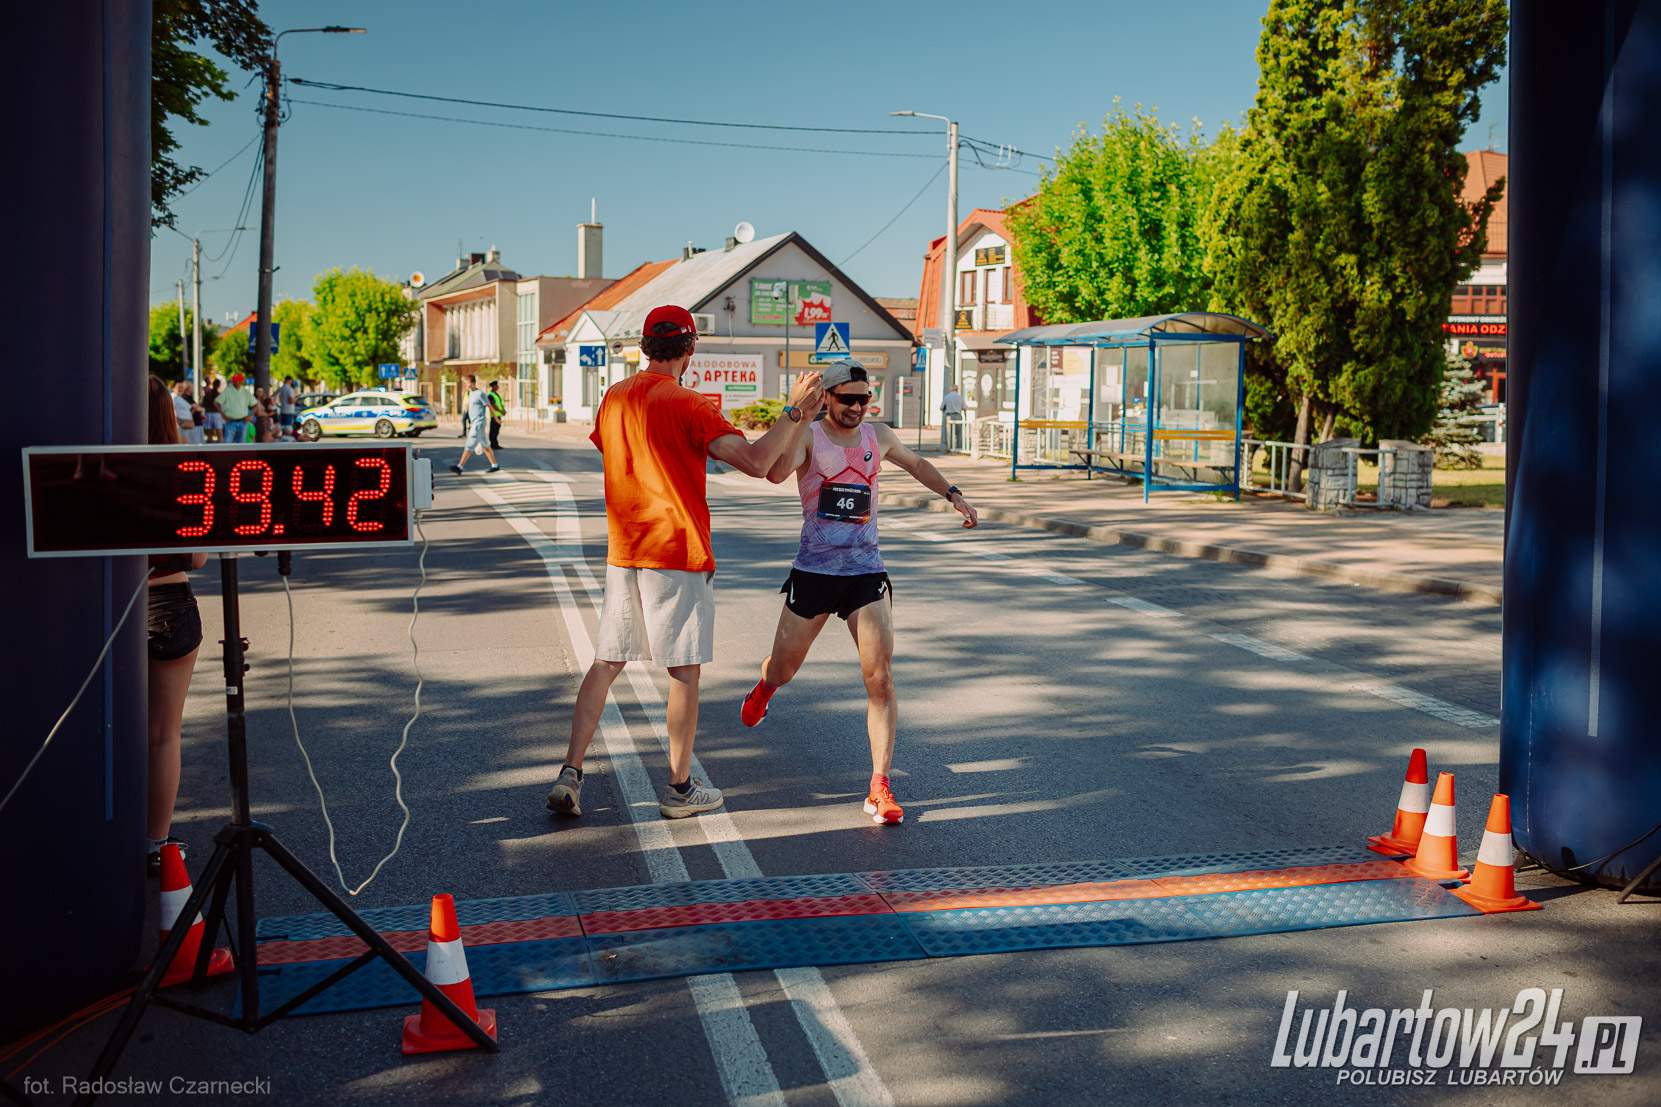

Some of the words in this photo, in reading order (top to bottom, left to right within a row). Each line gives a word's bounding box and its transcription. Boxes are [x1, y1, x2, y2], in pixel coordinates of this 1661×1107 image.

[1480, 324, 1506, 334] ODZ
[690, 359, 757, 368] AŁODOBOWA
[704, 370, 757, 382] APTEKA
[176, 457, 391, 538] 39.42
[836, 497, 855, 510] 46
